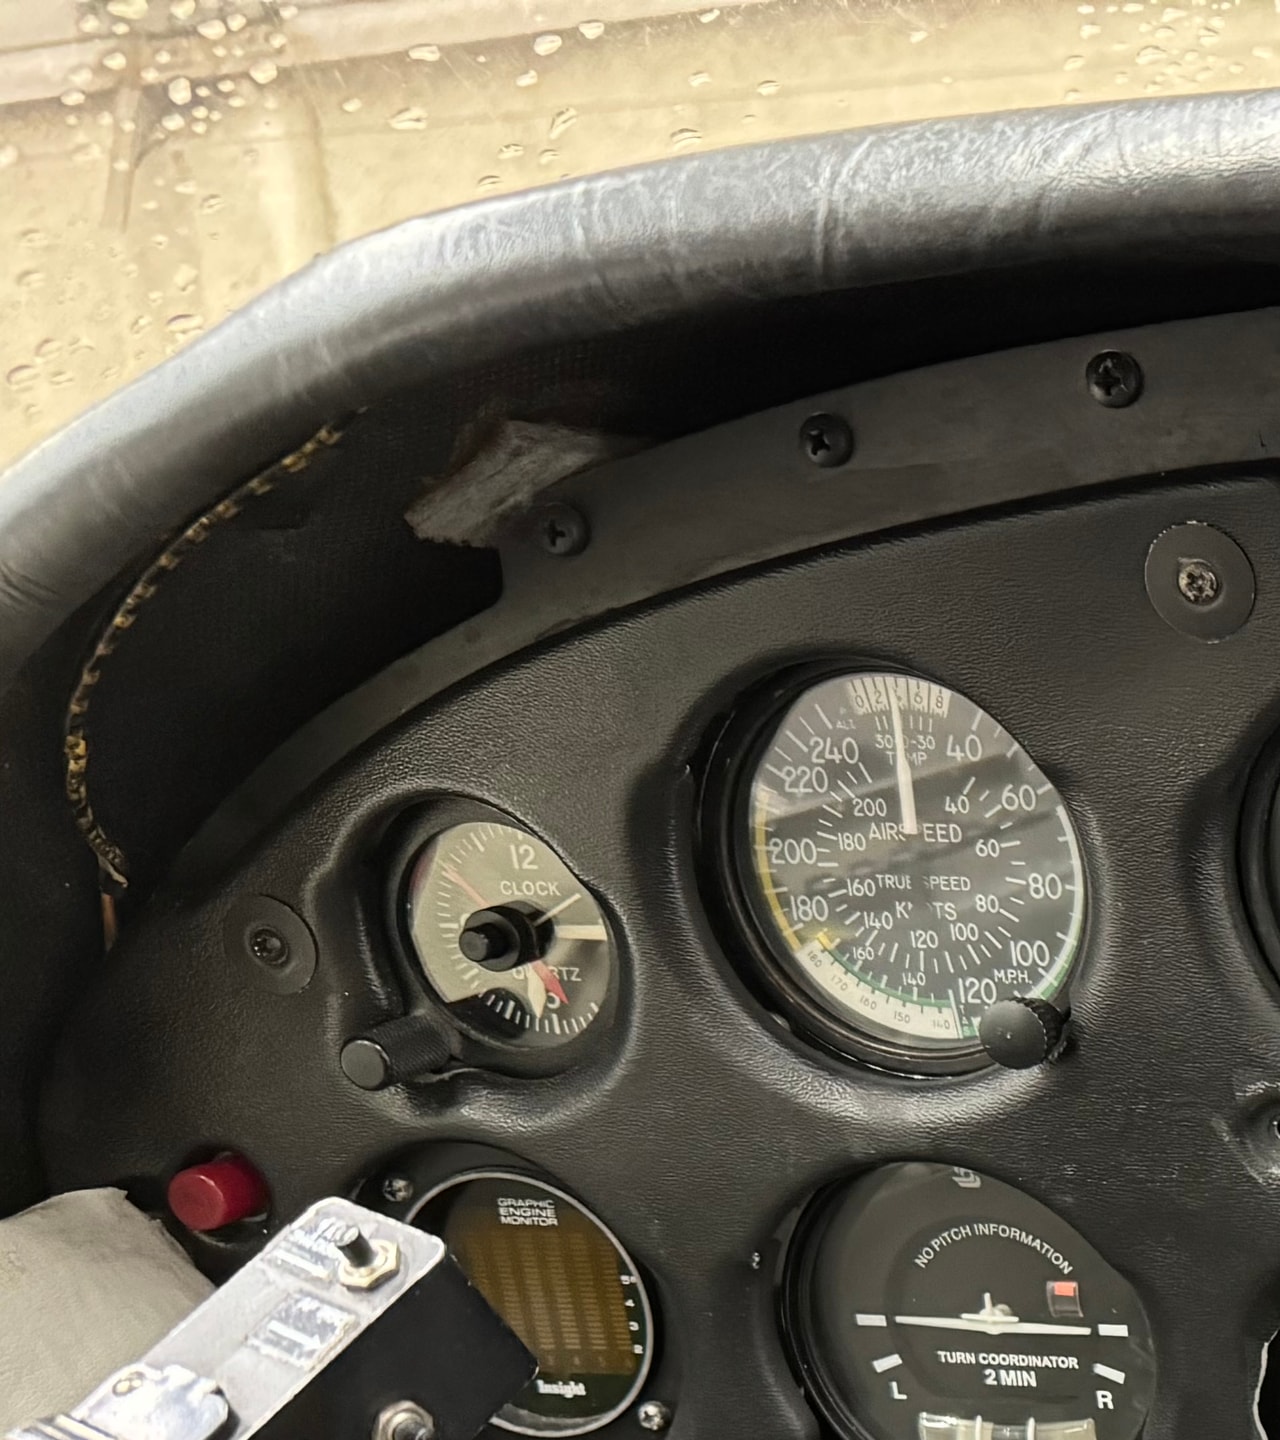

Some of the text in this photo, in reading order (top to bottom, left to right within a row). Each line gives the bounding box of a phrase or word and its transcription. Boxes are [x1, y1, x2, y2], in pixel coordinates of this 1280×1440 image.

[510, 844, 538, 870] 12
[500, 880, 561, 896] CLOCK
[937, 1350, 1080, 1370] TURN COORDINATOR
[983, 1369, 1038, 1388] 2 MIN
